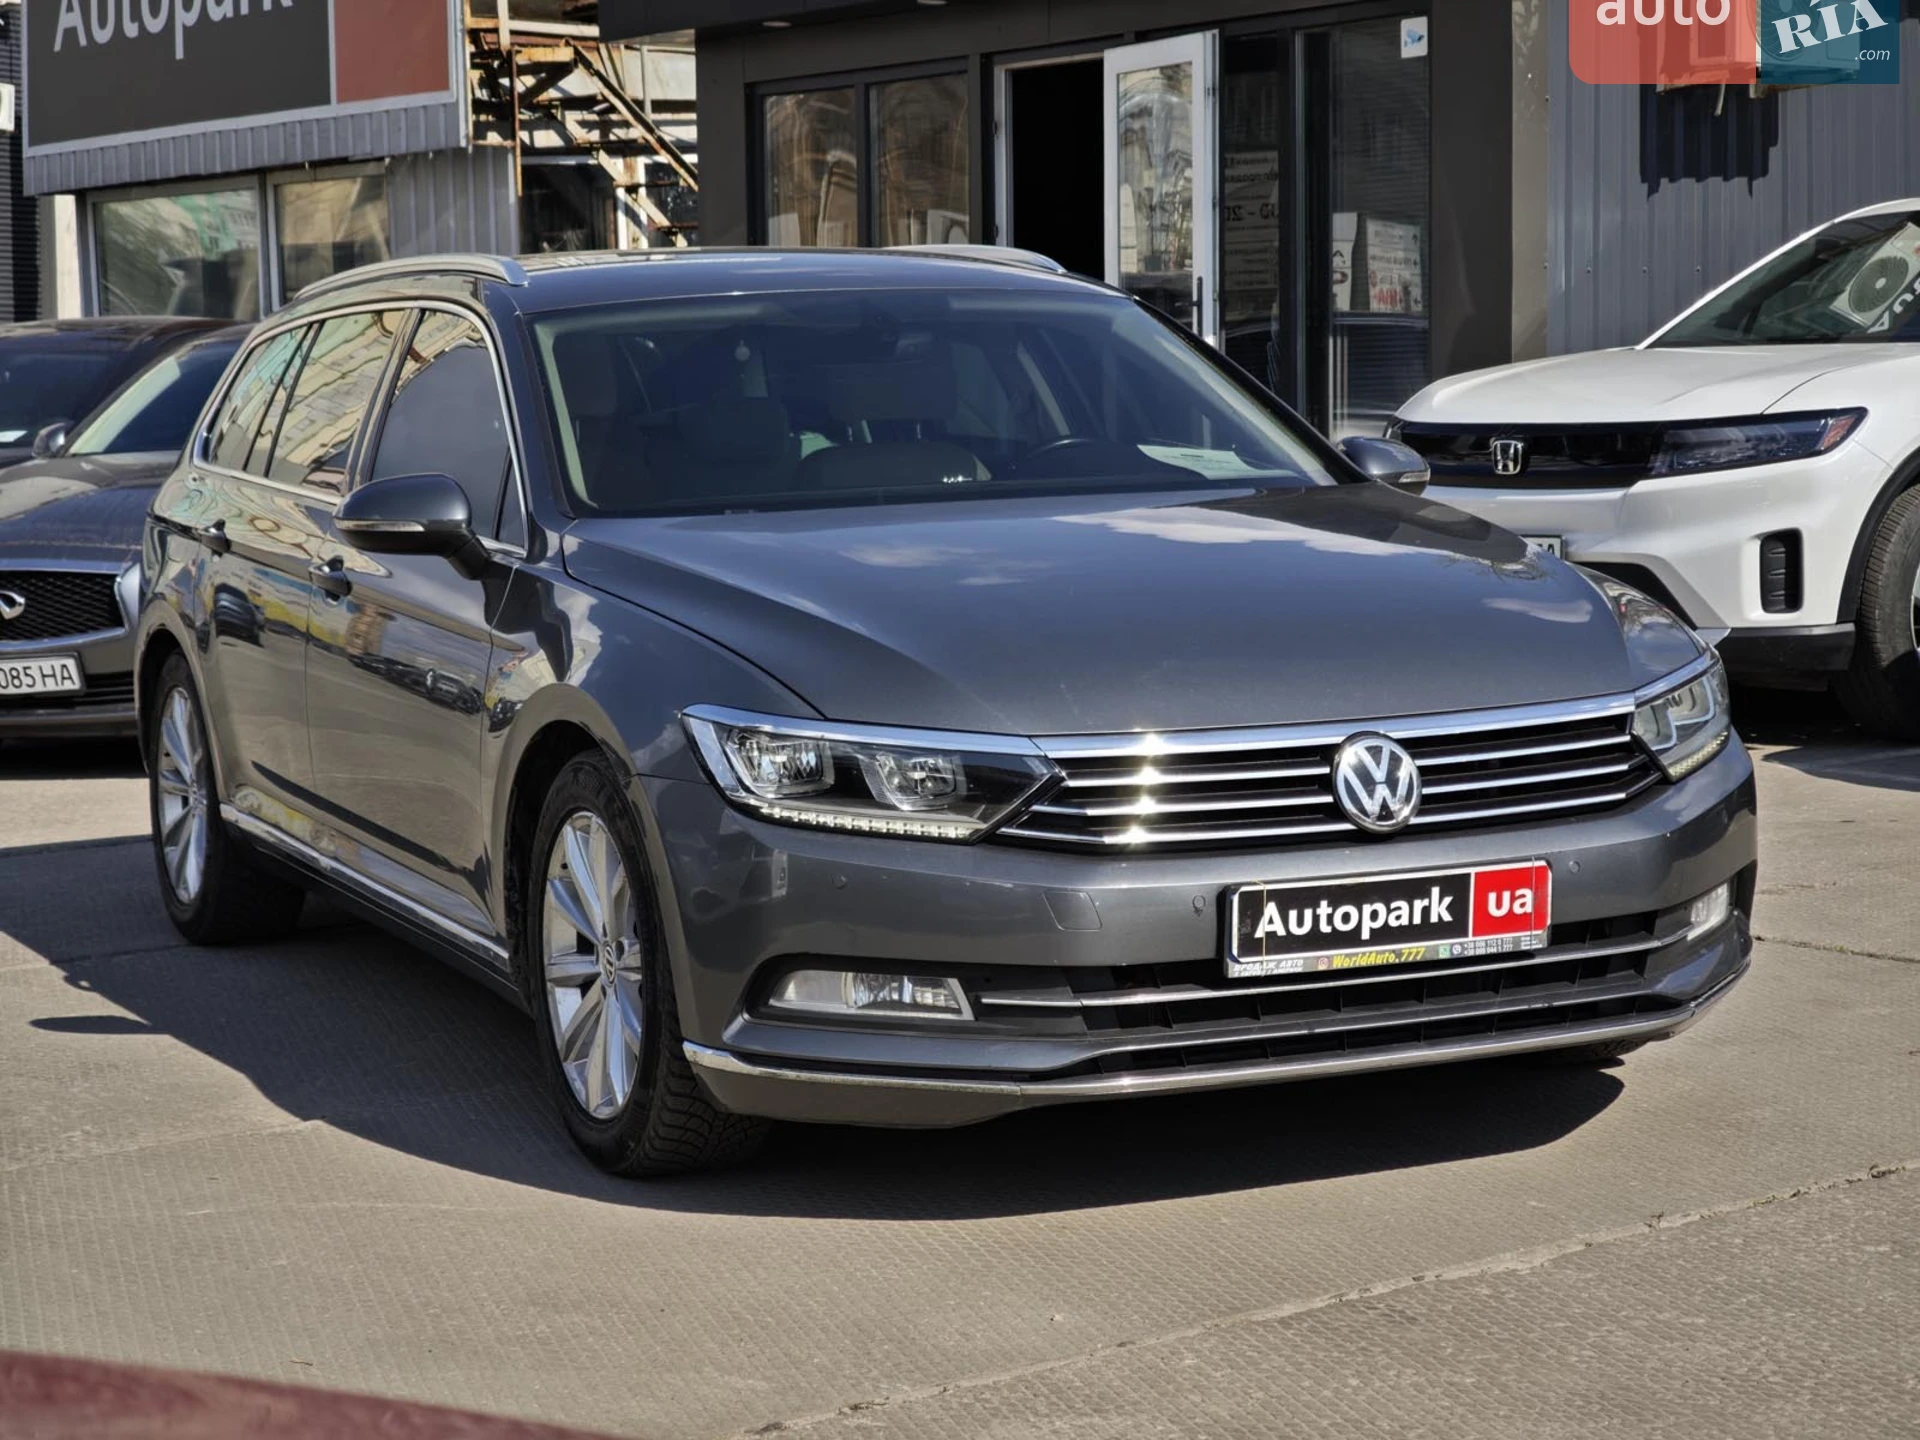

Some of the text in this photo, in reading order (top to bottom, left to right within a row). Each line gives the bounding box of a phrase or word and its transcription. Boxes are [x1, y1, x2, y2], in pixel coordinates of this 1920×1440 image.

[0, 664, 76, 689] 085 HA
[1254, 886, 1533, 940] Autopark ua
[1333, 947, 1426, 968] WorldAuto.777
